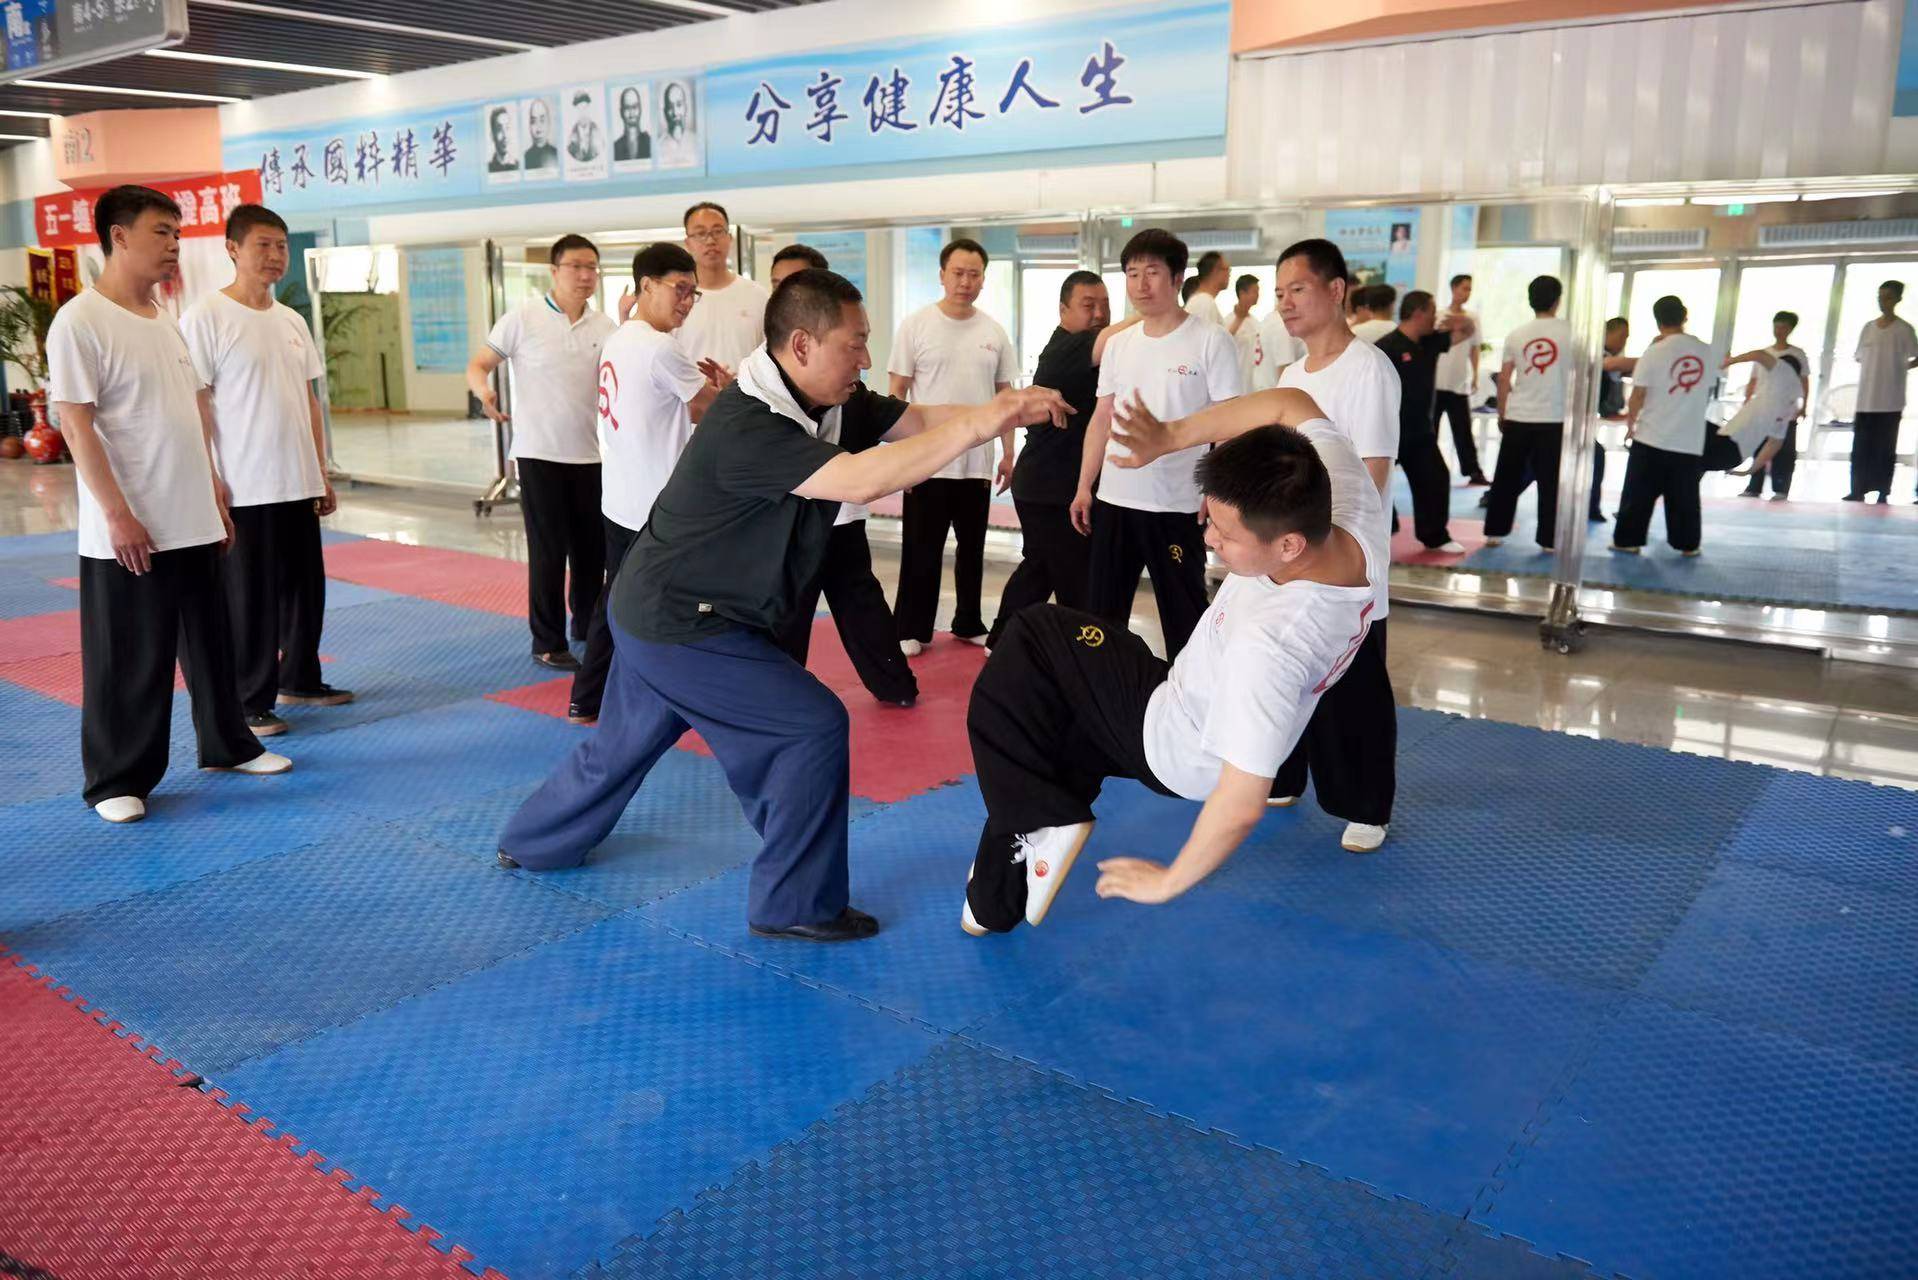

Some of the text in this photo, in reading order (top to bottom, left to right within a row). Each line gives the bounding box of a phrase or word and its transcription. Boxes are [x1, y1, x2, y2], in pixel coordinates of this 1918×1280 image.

[746, 42, 1133, 145] 分享健康人生
